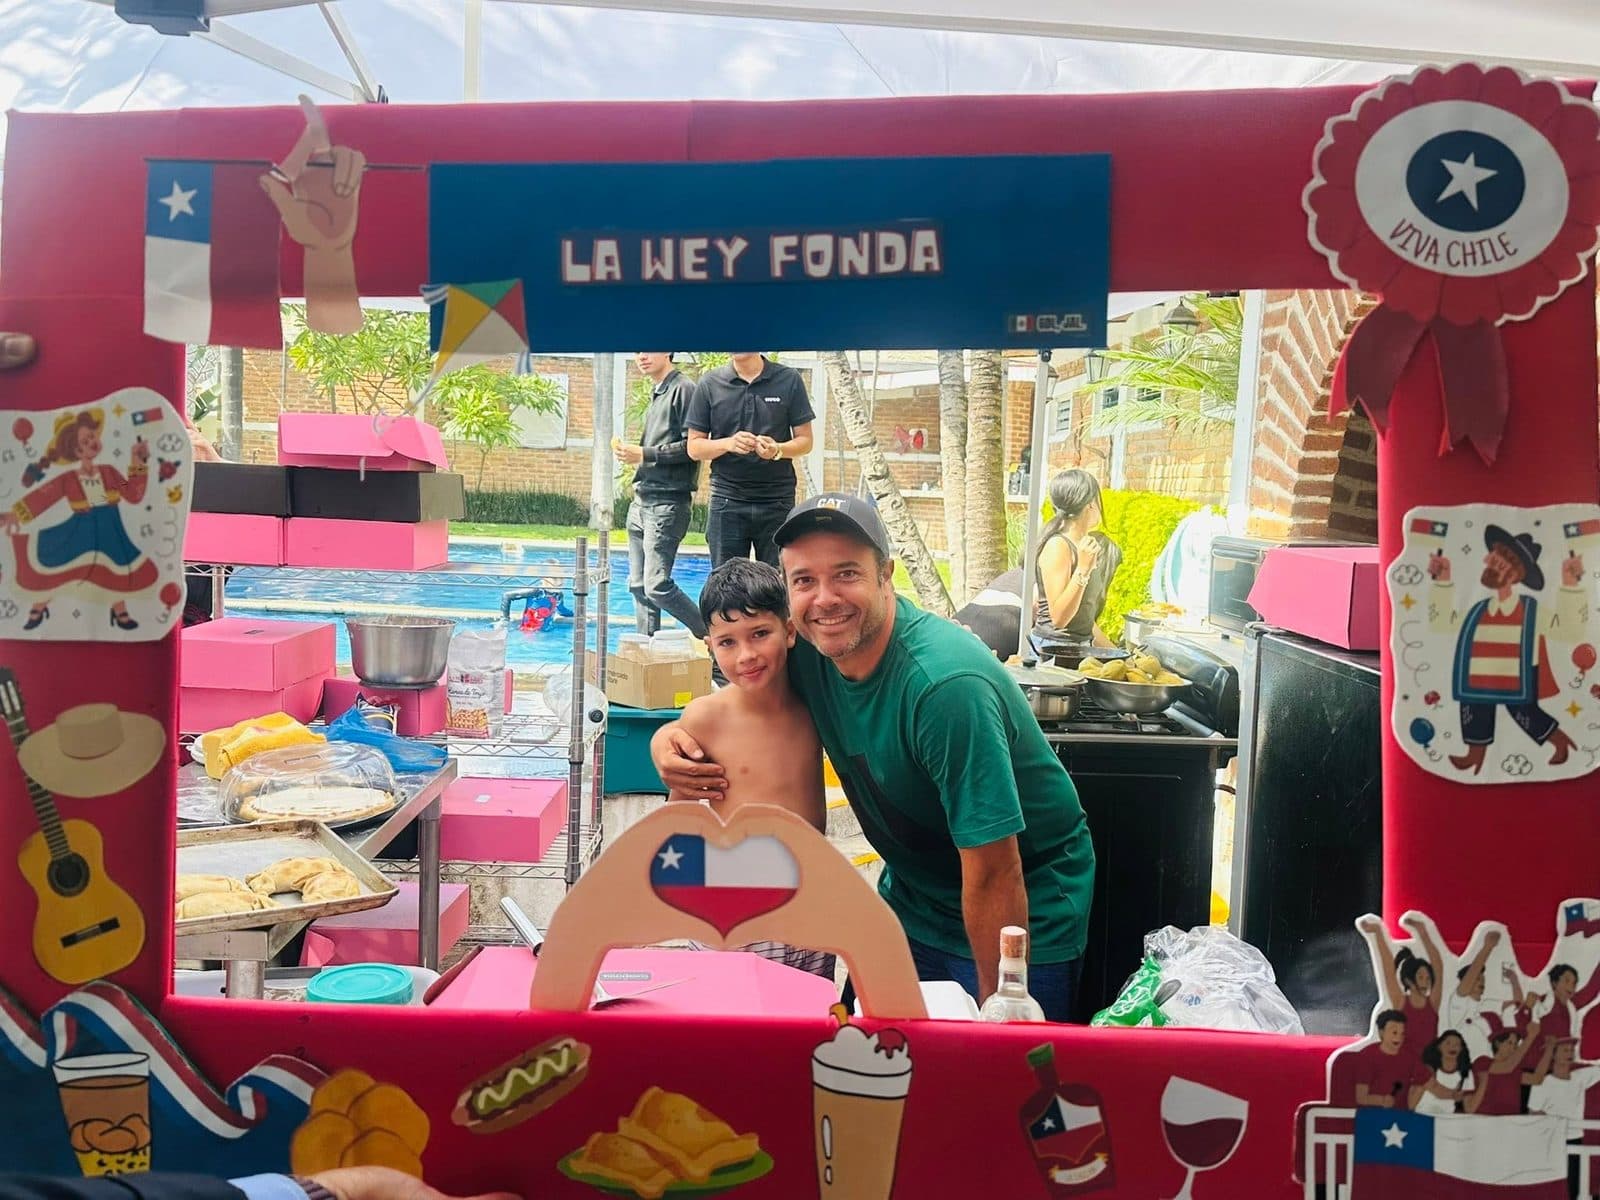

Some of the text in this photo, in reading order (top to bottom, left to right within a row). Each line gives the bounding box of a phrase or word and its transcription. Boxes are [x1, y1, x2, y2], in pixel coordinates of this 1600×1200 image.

[561, 229, 942, 282] LA WEY FONDA
[1389, 217, 1520, 268] VIVA CHILE
[817, 497, 847, 509] CAT
